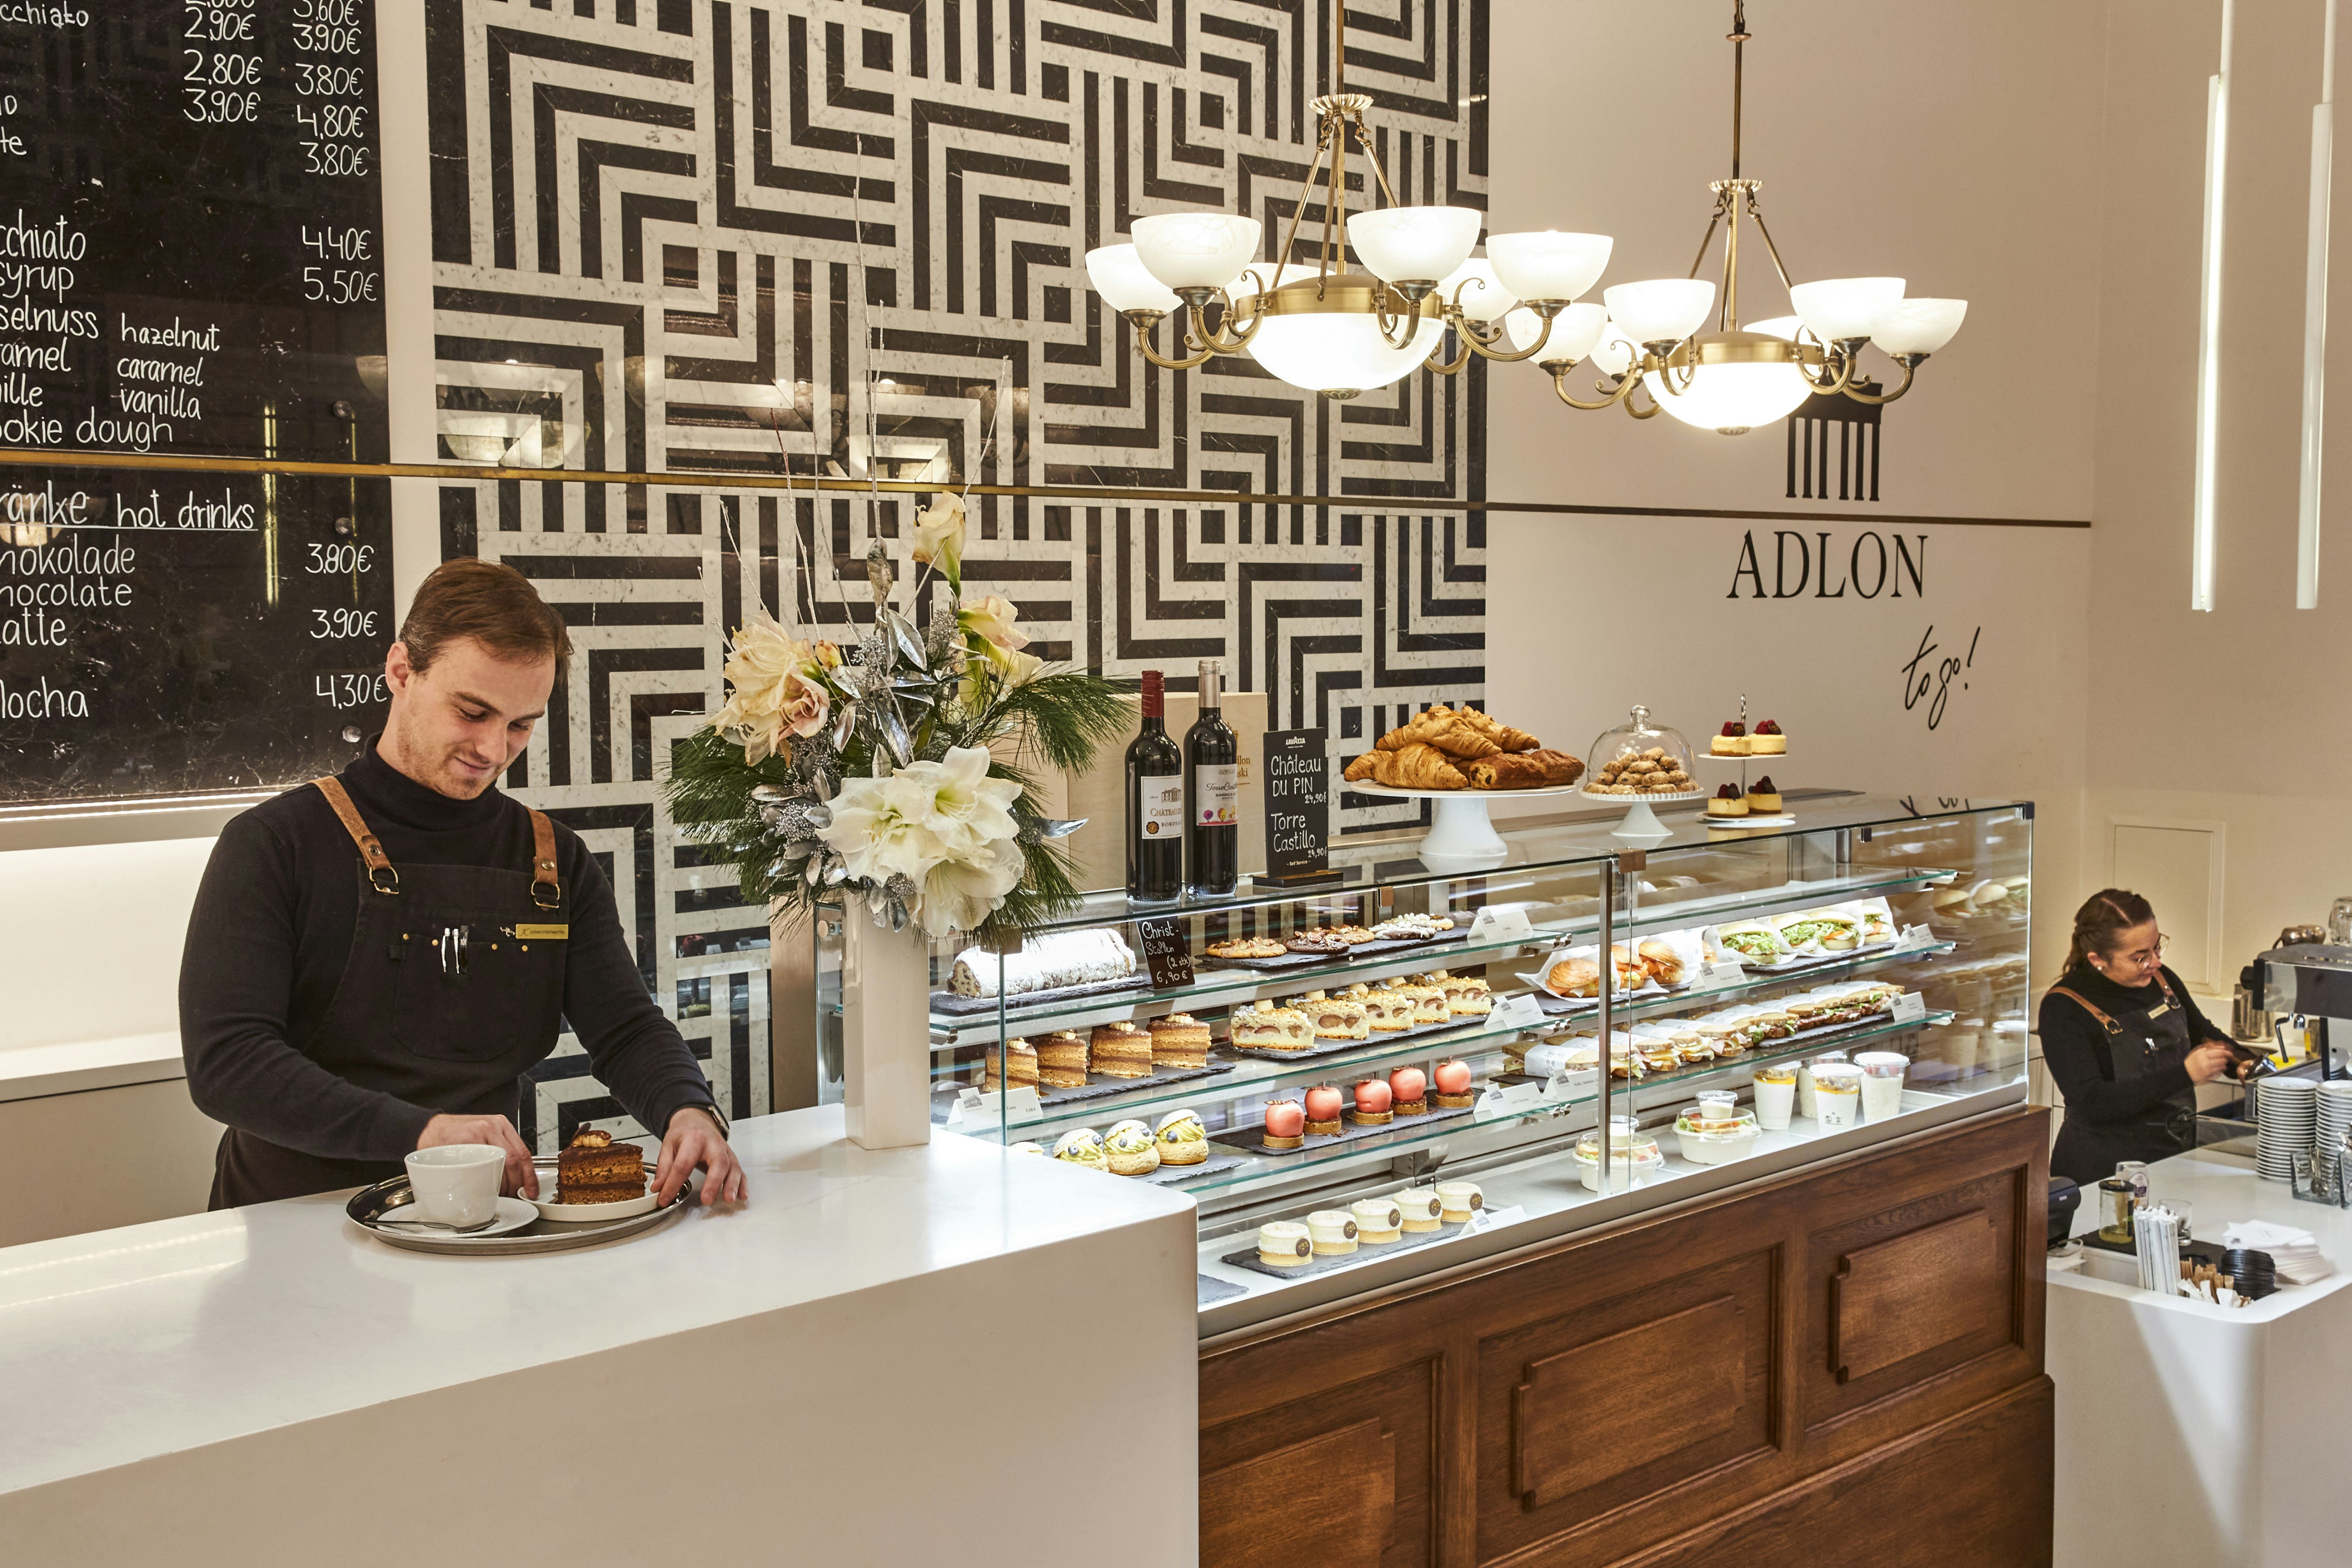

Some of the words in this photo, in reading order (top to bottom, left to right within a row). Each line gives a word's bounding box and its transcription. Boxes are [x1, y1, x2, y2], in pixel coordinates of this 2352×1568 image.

[122, 312, 220, 351] hazelnut
[0, 336, 71, 372] amel
[117, 357, 203, 386] caramel
[0, 372, 43, 406] ille
[121, 386, 201, 420] vanilla
[0, 409, 62, 444] okie
[76, 406, 173, 452] dough
[117, 489, 166, 527] hot
[178, 488, 254, 528] drinks
[1726, 529, 1928, 599] ADLON
[0, 607, 67, 645] atte
[1902, 625, 1938, 710] to
[1929, 626, 1980, 730] go!
[1286, 736, 1305, 745] LAVAZZA
[1271, 754, 1321, 775] Château
[1273, 780, 1287, 797] DU
[1294, 777, 1312, 795] PIN
[1271, 812, 1306, 831] Torre
[1274, 830, 1315, 852] Castillo
